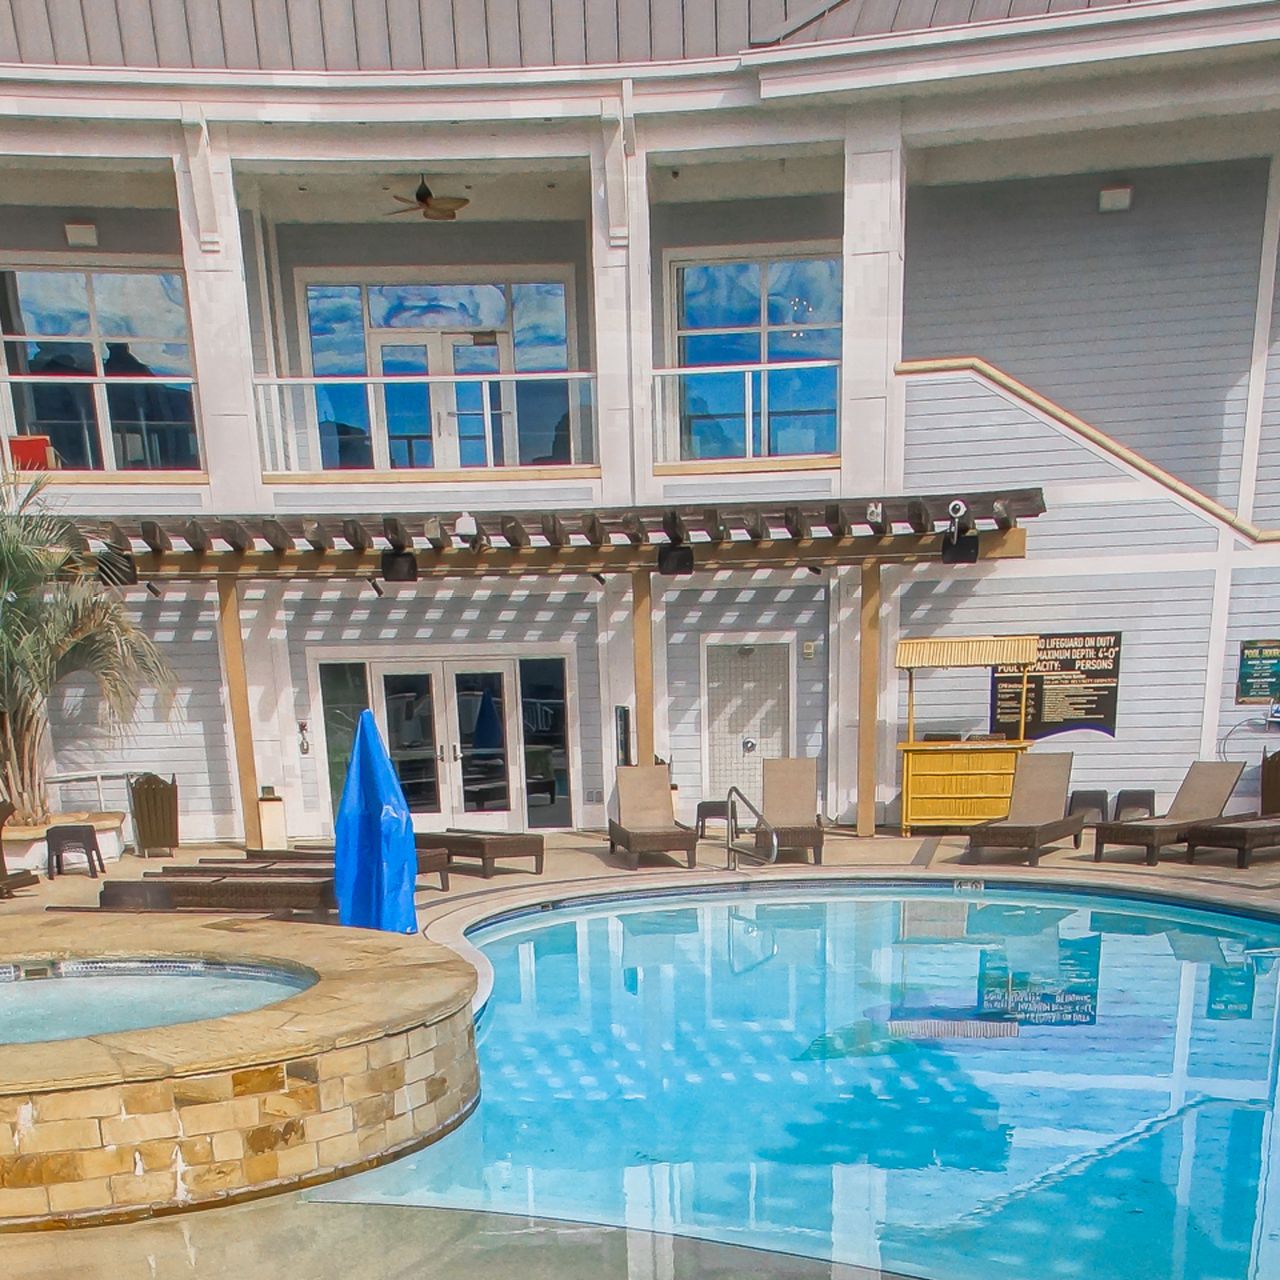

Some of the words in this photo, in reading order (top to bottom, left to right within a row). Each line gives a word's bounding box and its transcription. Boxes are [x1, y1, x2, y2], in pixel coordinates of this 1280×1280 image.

[1046, 637, 1083, 648] LIFEGUARD
[1084, 637, 1096, 647] ON
[1097, 636, 1115, 647] DUTY
[1036, 648, 1071, 660] MAXIMUM
[1071, 648, 1097, 659] DEPTH:
[1075, 660, 1113, 670] PERSONS
